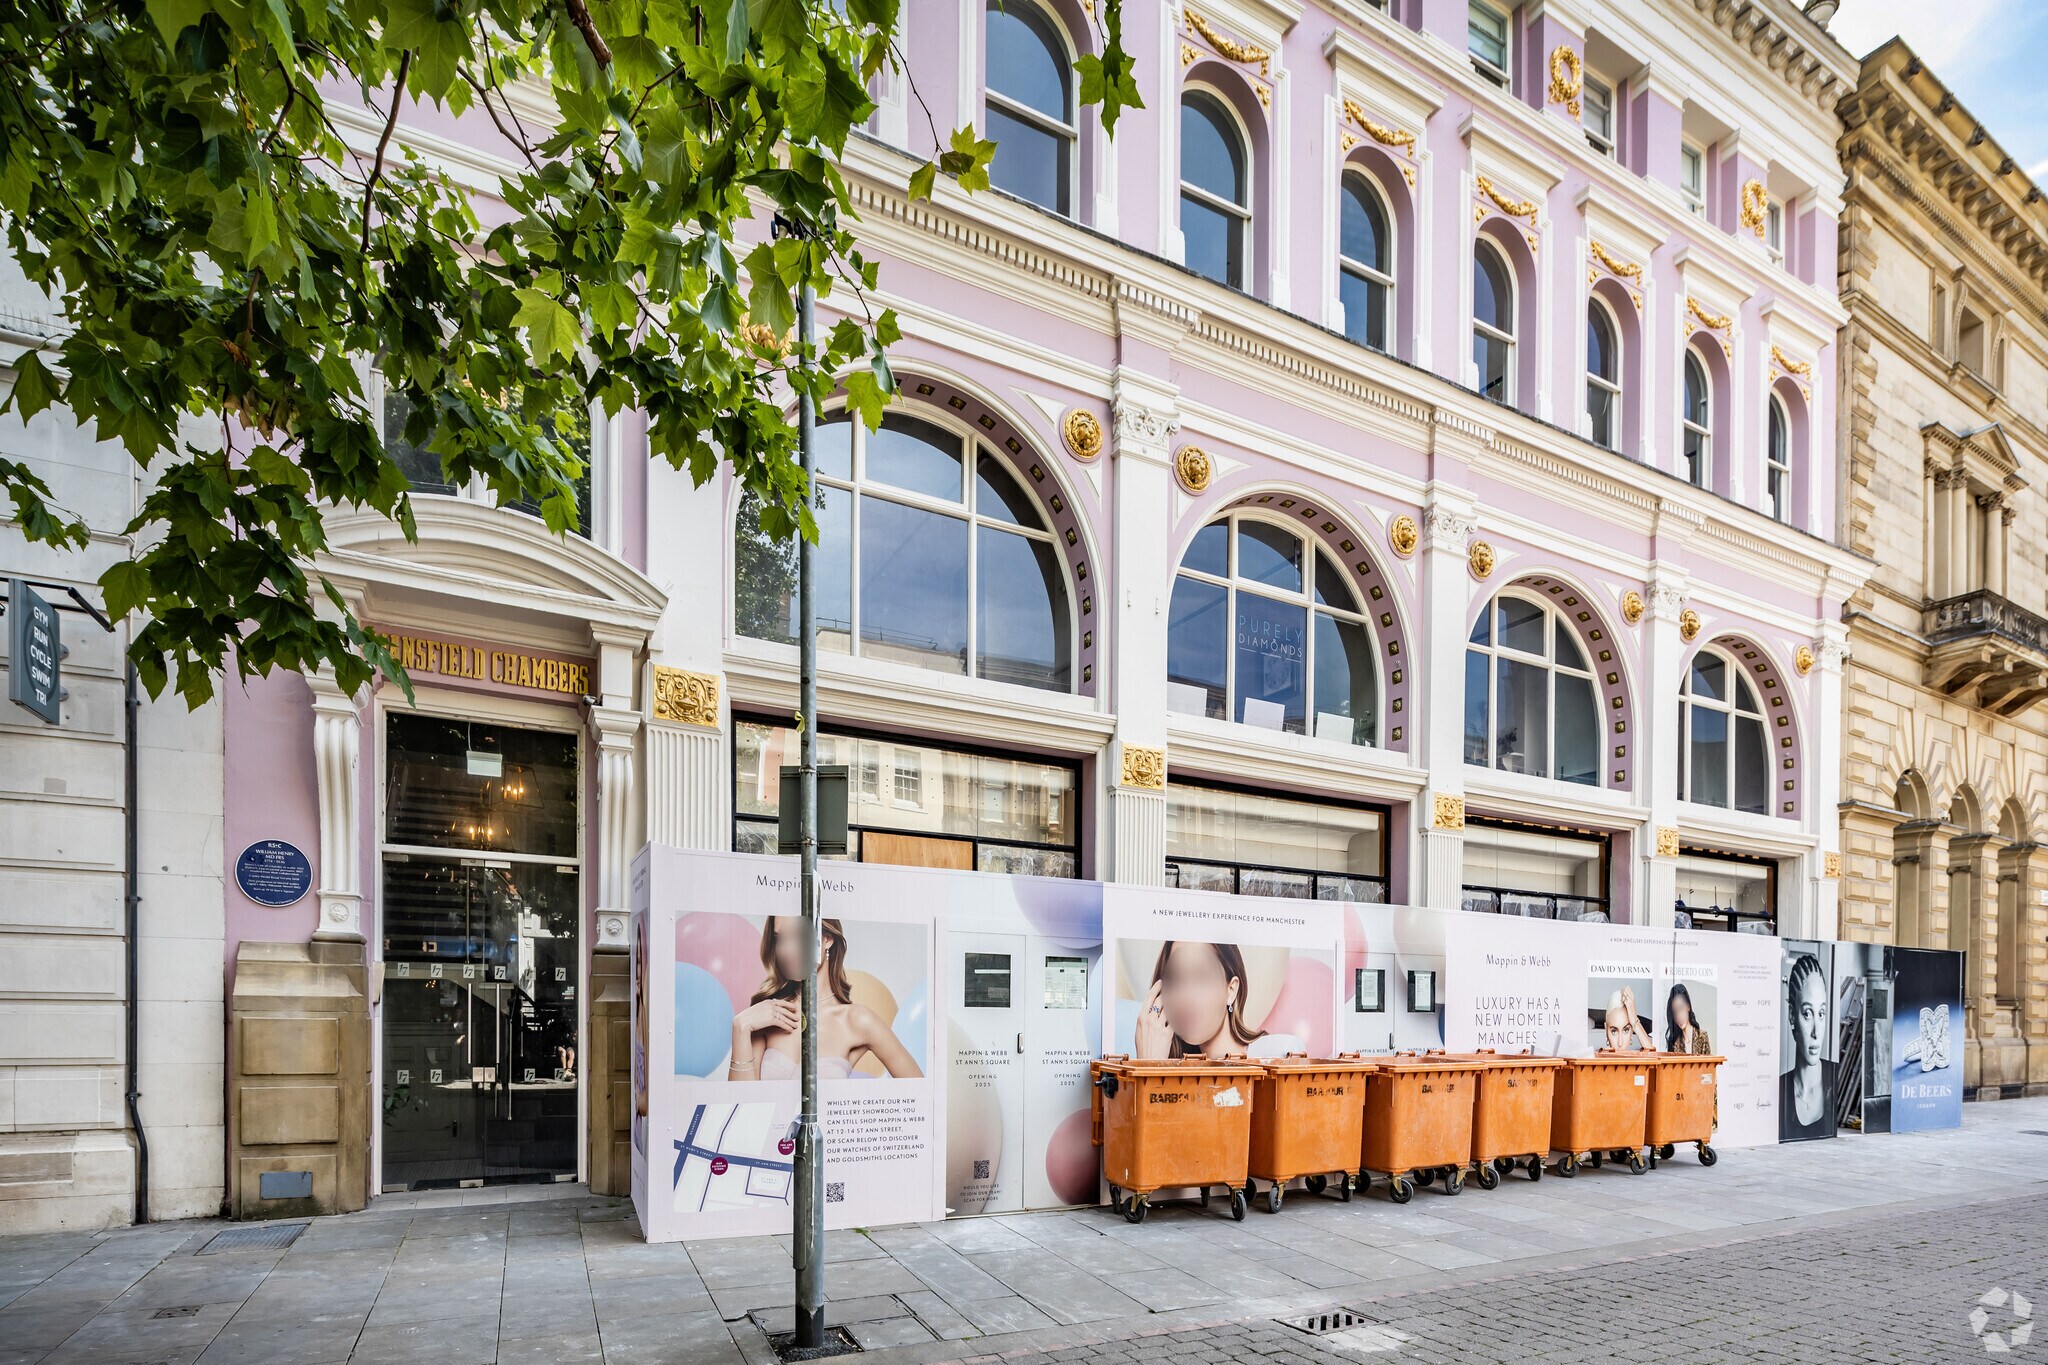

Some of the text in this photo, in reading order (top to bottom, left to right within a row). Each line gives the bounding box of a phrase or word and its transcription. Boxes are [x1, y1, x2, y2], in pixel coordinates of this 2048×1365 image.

[34, 607, 48, 627] GYM
[1239, 615, 1302, 643] PURELY
[34, 626, 48, 647] RUN
[1239, 634, 1302, 657] DIAMONDS
[30, 645, 51, 669] CYCLE
[32, 666, 50, 688] SWIM
[491, 650, 590, 695] CHAMBERS
[36, 689, 46, 705] TRI
[822, 880, 854, 892] Webb
[1213, 913, 1250, 921] EXPERIENCE
[1266, 917, 1305, 925] MANCHESTER
[1486, 954, 1551, 968] Mappin & Webb
[496, 968, 504, 978] 17
[557, 969, 564, 979] 17
[1476, 997, 1560, 1010] LUXURY HAS A
[1476, 1013, 1560, 1026] NEW HOME IN
[399, 1072, 407, 1082] 17
[432, 1071, 440, 1081] 17
[526, 1070, 534, 1080] 17
[556, 1070, 563, 1079] 17
[1920, 1084, 1952, 1097] BEERS
